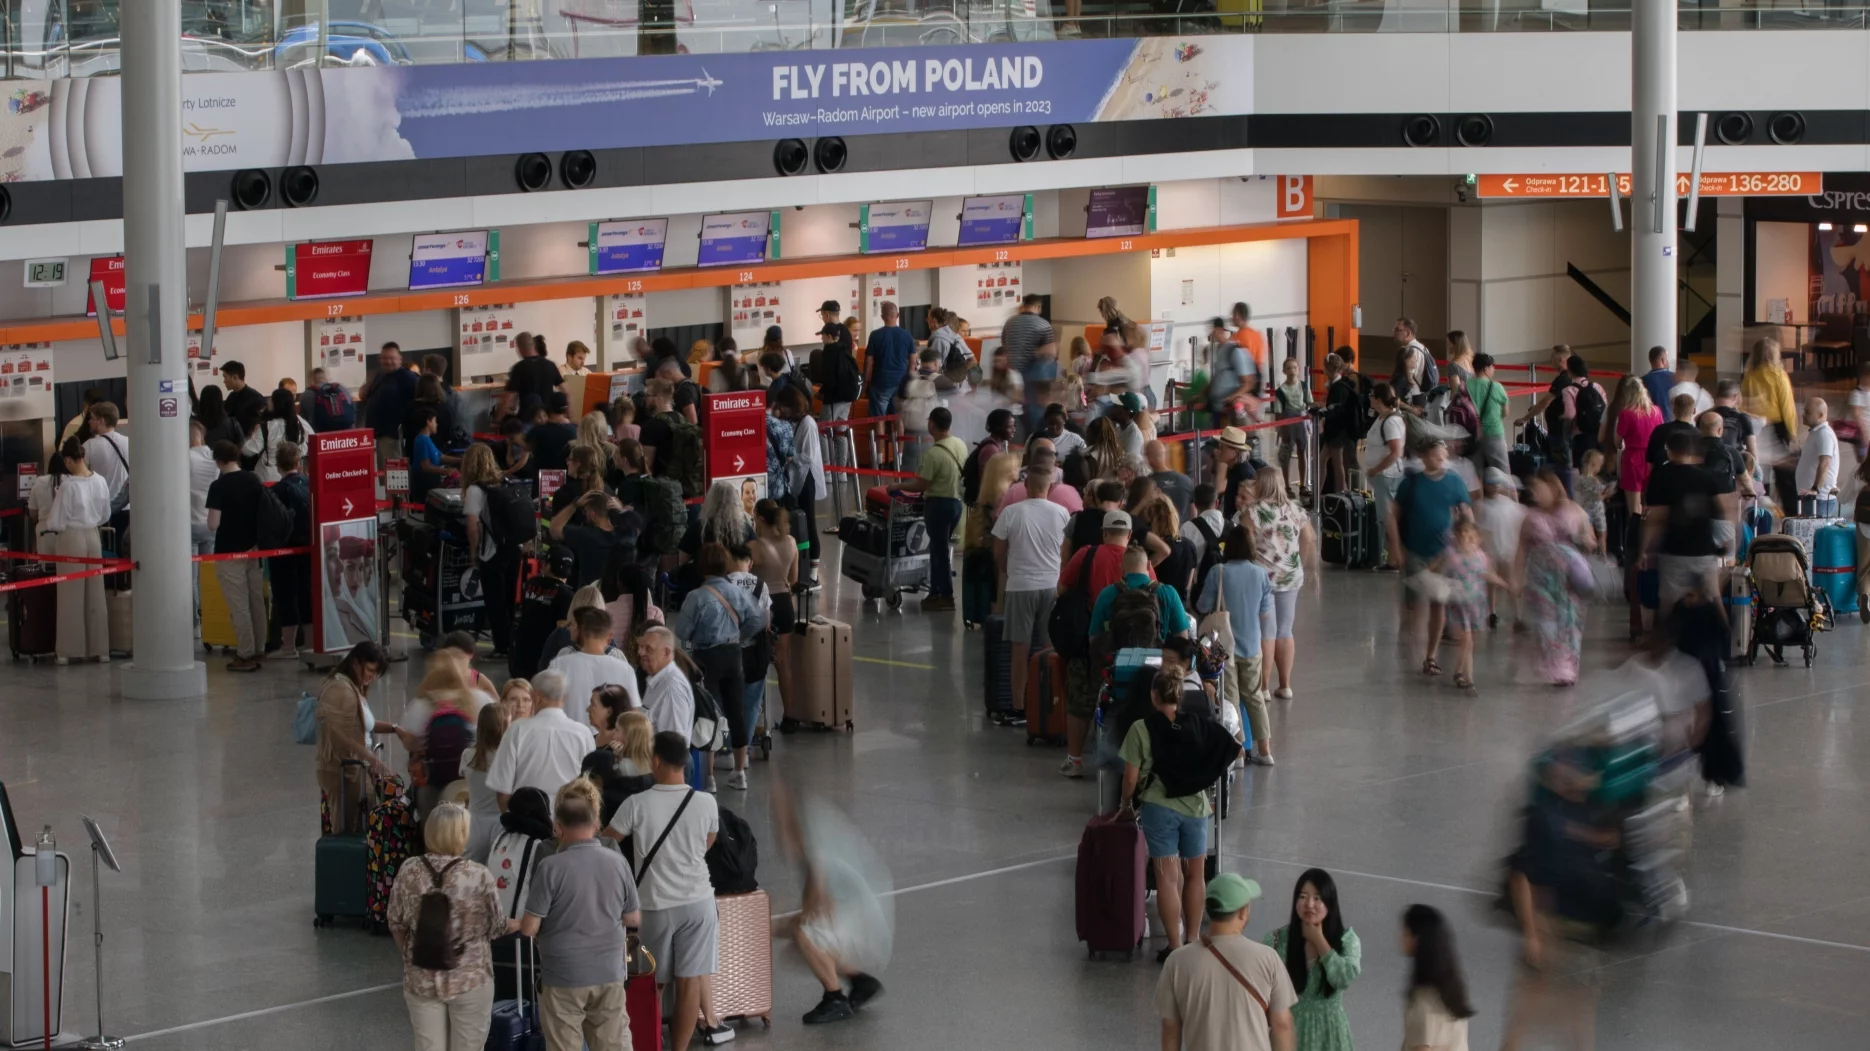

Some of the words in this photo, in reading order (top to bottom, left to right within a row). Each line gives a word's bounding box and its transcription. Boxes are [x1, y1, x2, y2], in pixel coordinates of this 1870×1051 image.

[773, 64, 826, 100] FLY
[832, 60, 917, 97] FROM
[925, 56, 1043, 92] POLAND
[183, 99, 195, 111] rty
[198, 97, 236, 108] Lotnicze
[861, 105, 900, 123] Airport
[912, 106, 936, 117] new
[938, 102, 974, 119] airport
[977, 102, 1011, 117] opens
[1013, 99, 1023, 113] in
[1025, 100, 1051, 114] 2023
[183, 144, 237, 156] WA-RADOM
[1525, 177, 1556, 188] Odprawa
[1559, 176, 1631, 193] 121-15
[1729, 175, 1802, 192] 136-280
[1286, 175, 1305, 212] B
[312, 245, 343, 255] Emirates
[1121, 240, 1133, 250] 121
[995, 250, 1008, 260] 122
[895, 259, 909, 269] 123
[33, 263, 64, 281] 12:19
[312, 271, 337, 279] Economy
[739, 272, 753, 282] 124
[627, 281, 642, 291] 125
[454, 294, 469, 305] 126
[328, 304, 343, 315] 127
[713, 397, 750, 411] Emirates
[721, 430, 743, 438] Economy
[320, 437, 358, 451] Emirates
[325, 471, 341, 480] Online
[342, 469, 369, 478] Checked-in
